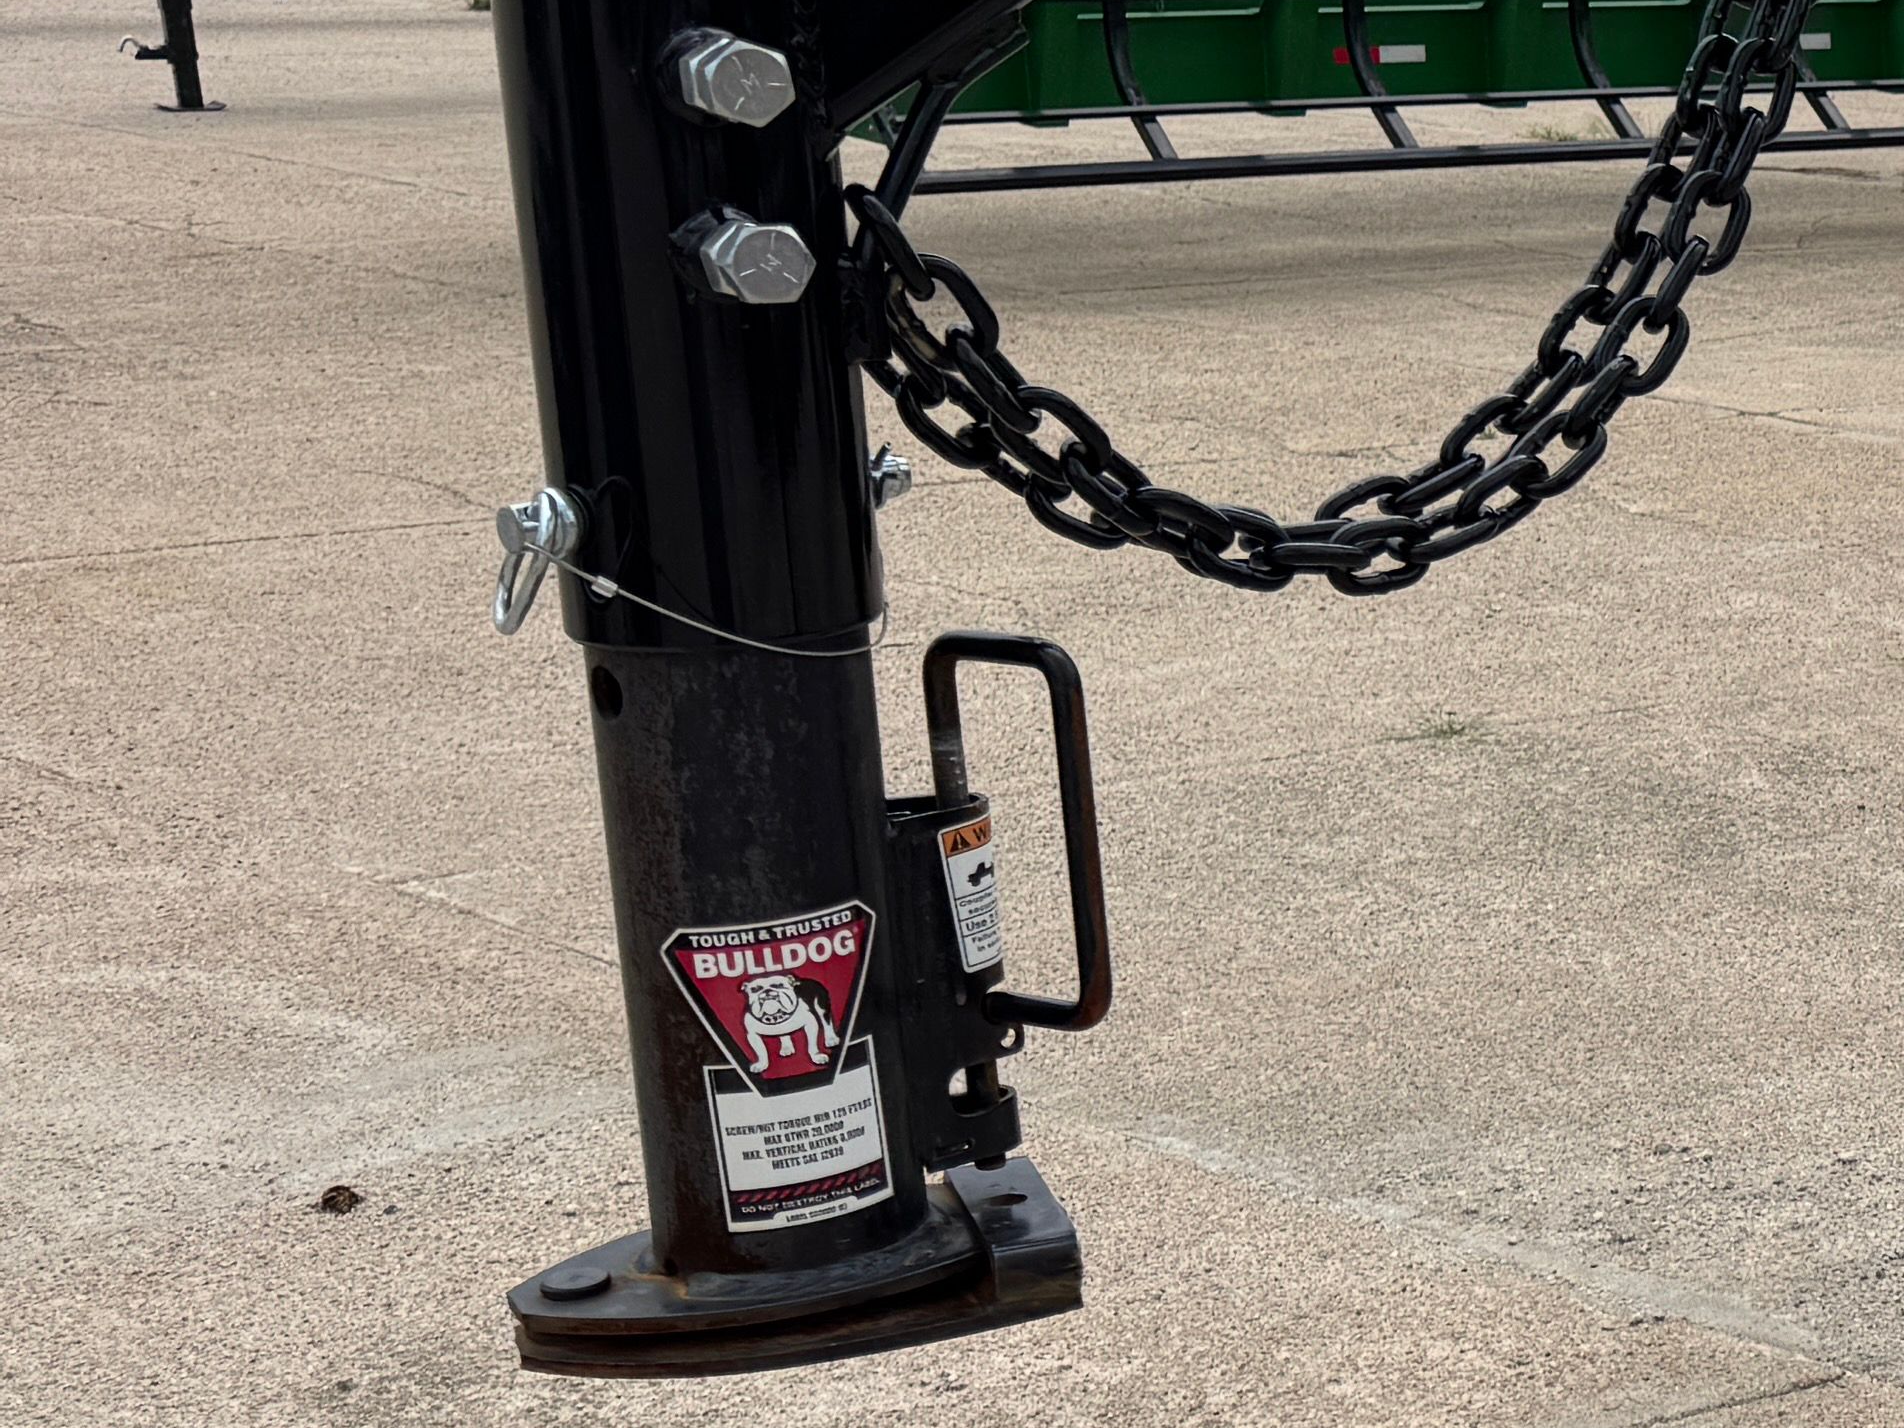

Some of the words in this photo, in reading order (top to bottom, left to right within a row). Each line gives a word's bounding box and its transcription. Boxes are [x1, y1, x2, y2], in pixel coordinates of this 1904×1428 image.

[689, 930, 754, 948] TOUGH
[757, 930, 771, 941] &
[772, 910, 852, 939] TRUSTED
[966, 918, 987, 932] Use
[692, 929, 856, 979] BULLDOG
[765, 1143, 807, 1159] VERTICAL
[772, 1158, 800, 1170] MEETS
[741, 1206, 756, 1214] DO
[758, 1202, 780, 1213] NOT
